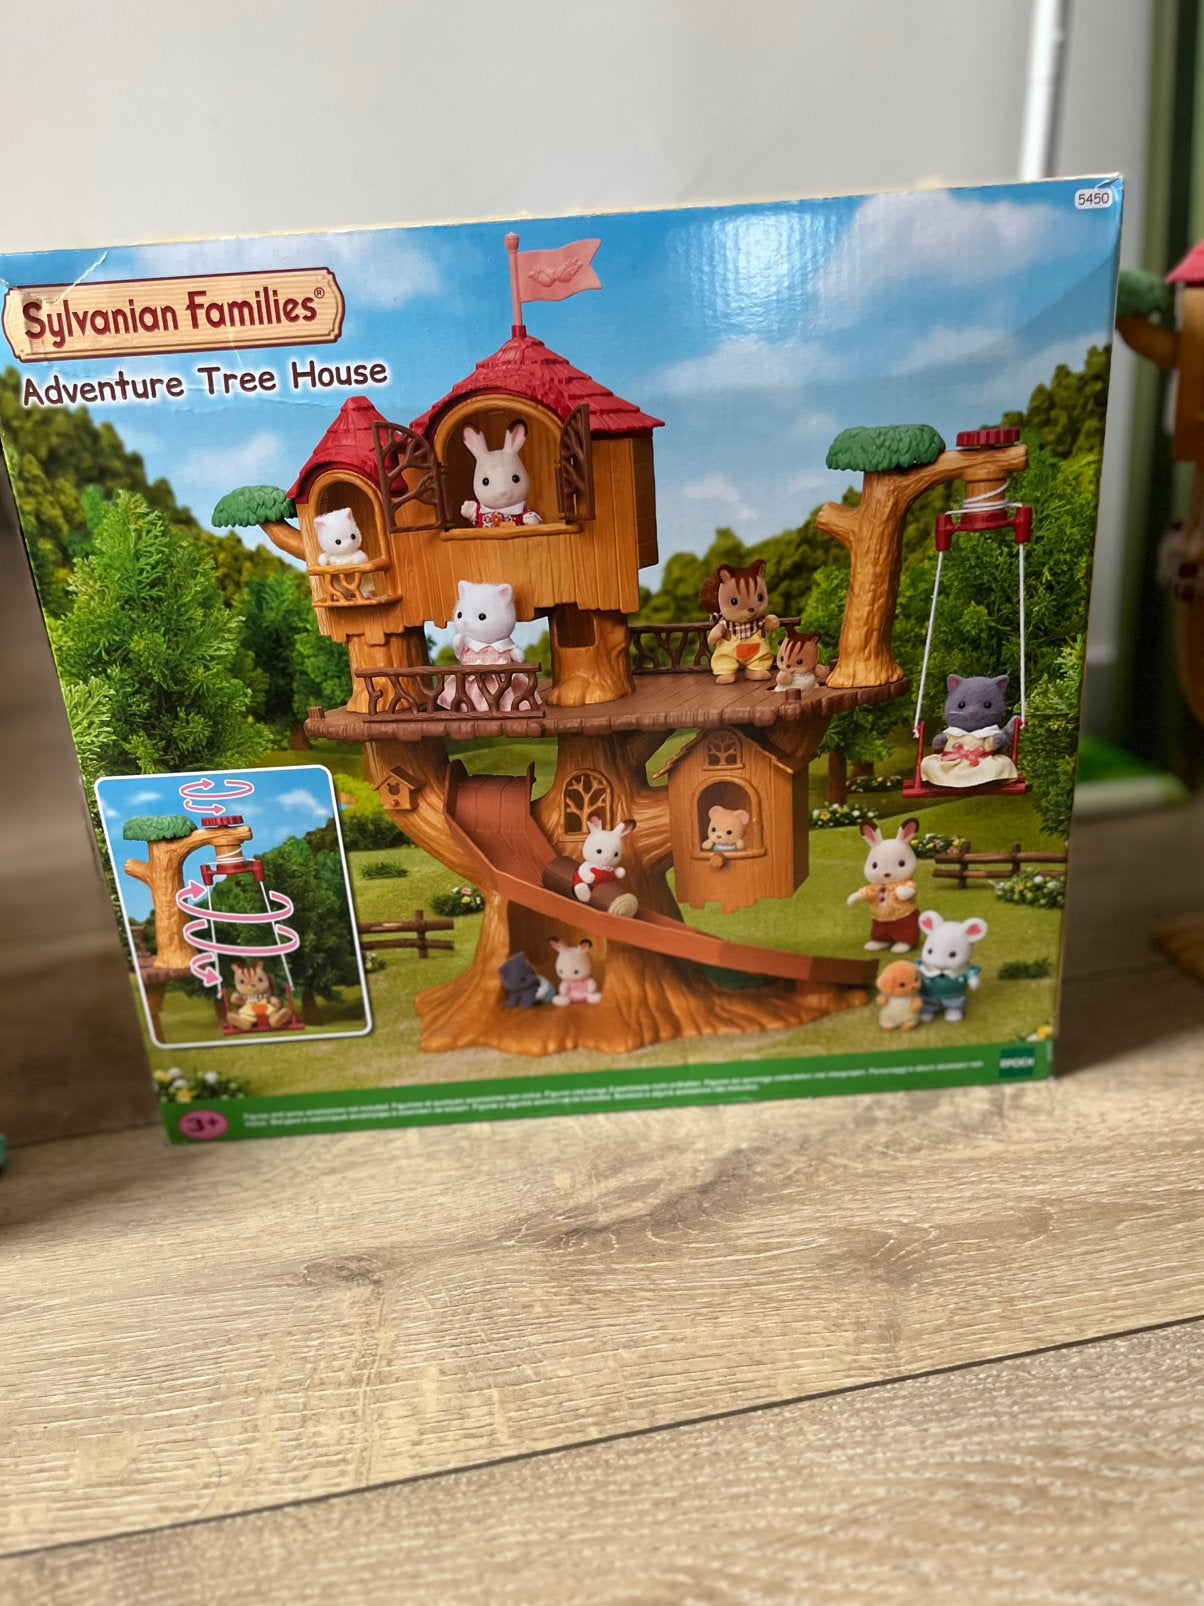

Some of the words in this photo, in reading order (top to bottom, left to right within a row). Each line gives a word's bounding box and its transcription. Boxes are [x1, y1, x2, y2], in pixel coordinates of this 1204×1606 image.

[1078, 192, 1109, 206] 5450
[22, 298, 180, 349] Sylvanian
[23, 371, 184, 406] Adventure
[197, 366, 278, 395] Tree
[291, 360, 389, 390] House
[186, 1116, 220, 1133] 3+
